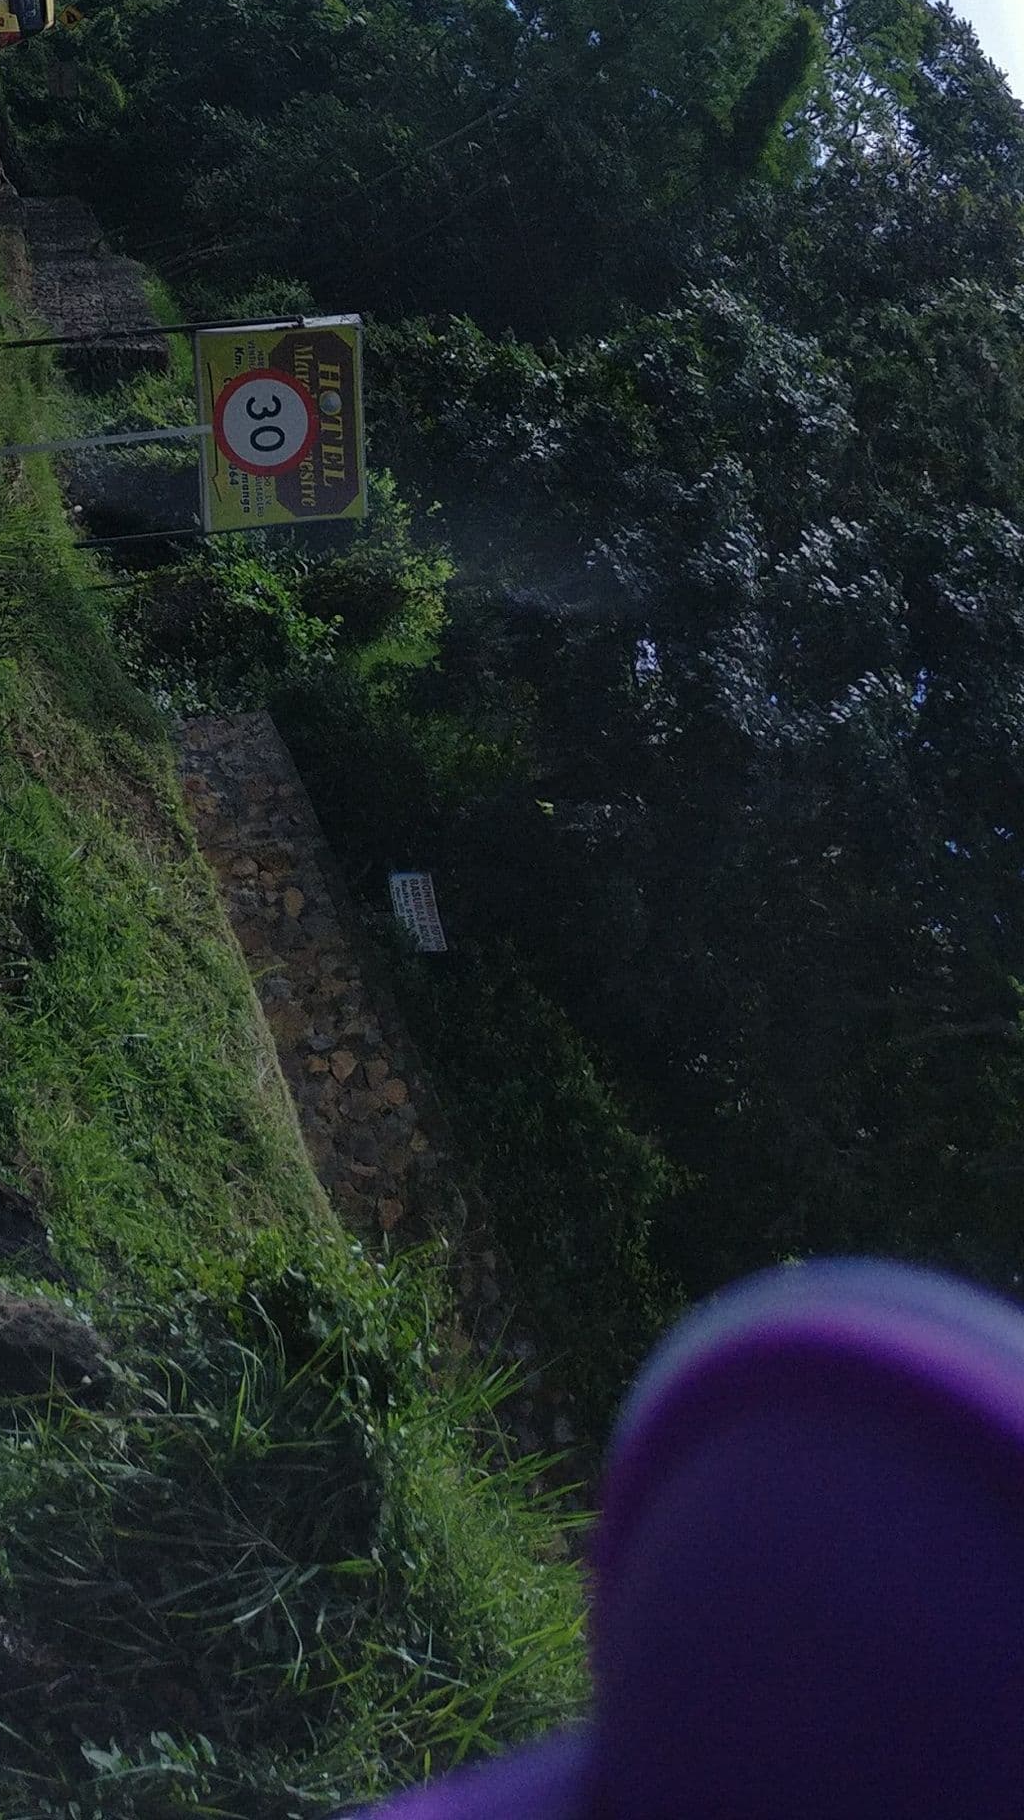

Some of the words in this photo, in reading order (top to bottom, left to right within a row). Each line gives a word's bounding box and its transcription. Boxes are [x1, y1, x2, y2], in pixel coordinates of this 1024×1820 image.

[234, 347, 244, 369] Km.
[240, 474, 250, 513] manga
[246, 395, 285, 452] 30
[317, 362, 345, 486] HOTEL
